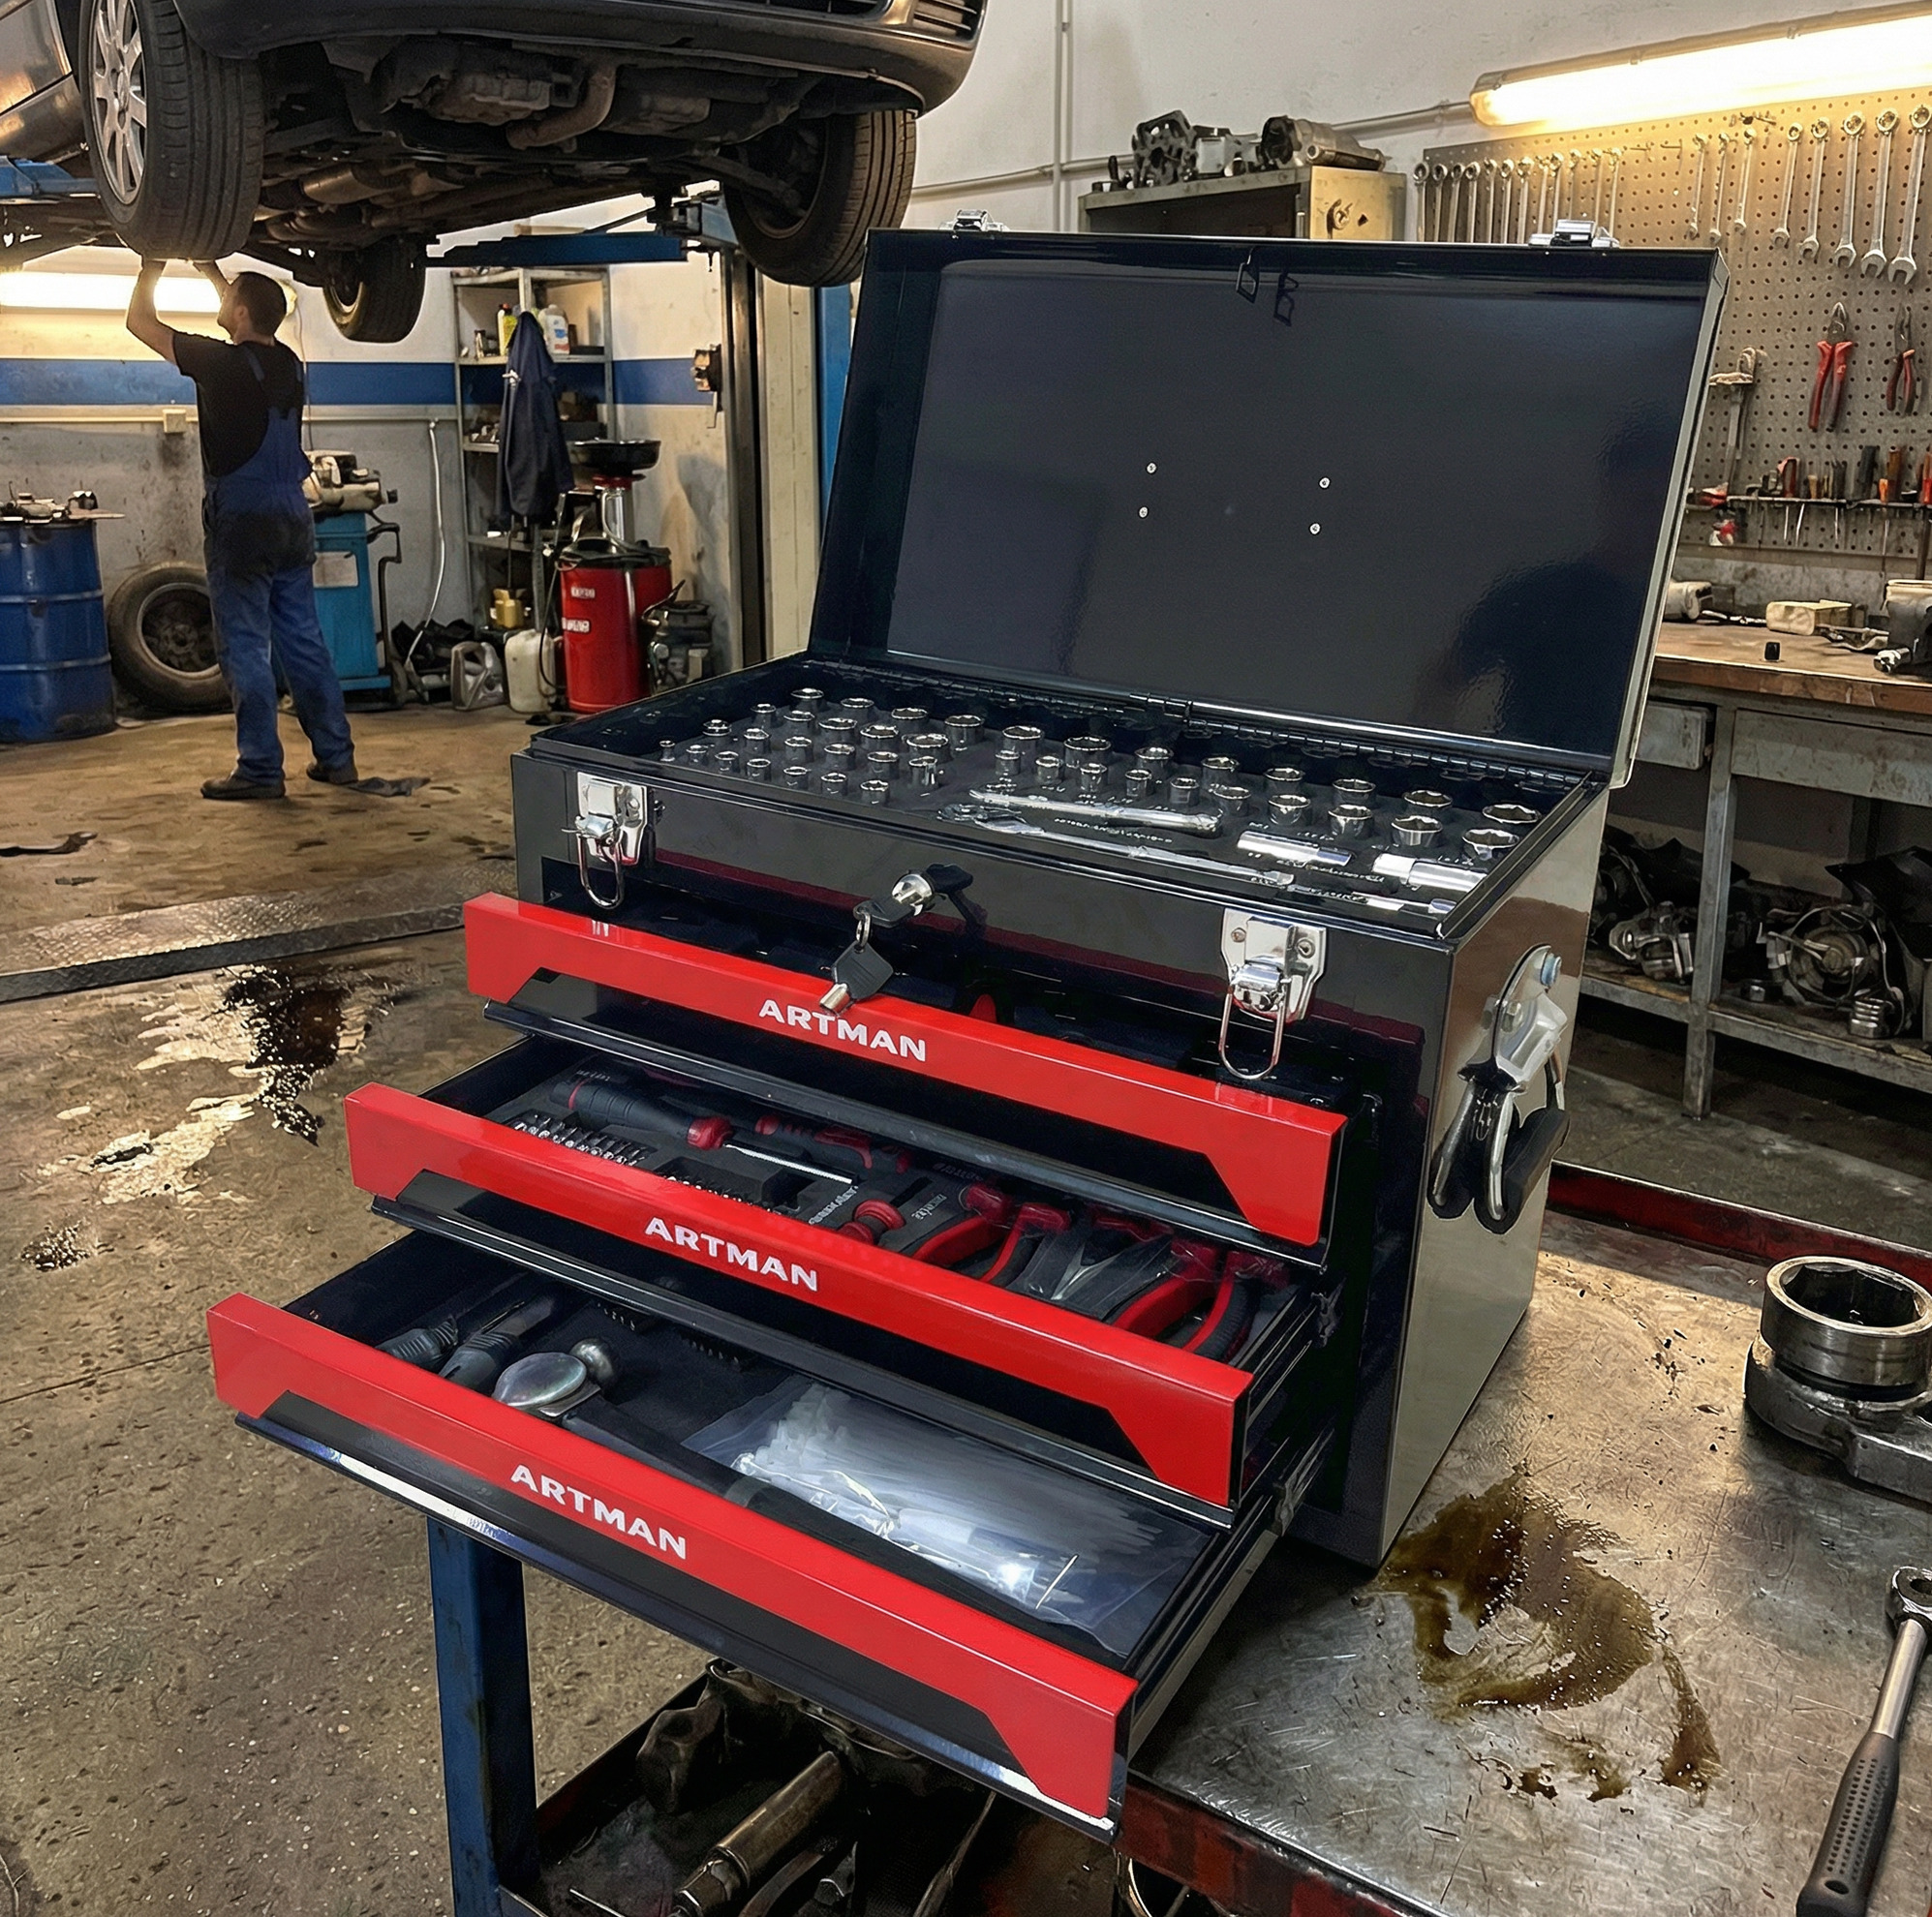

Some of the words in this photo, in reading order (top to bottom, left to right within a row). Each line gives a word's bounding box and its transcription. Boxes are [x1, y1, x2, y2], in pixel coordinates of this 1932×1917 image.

[758, 999, 927, 1062] ARTMAN
[645, 1217, 818, 1292] ARTMAN
[510, 1464, 687, 1560] ARTMAN
